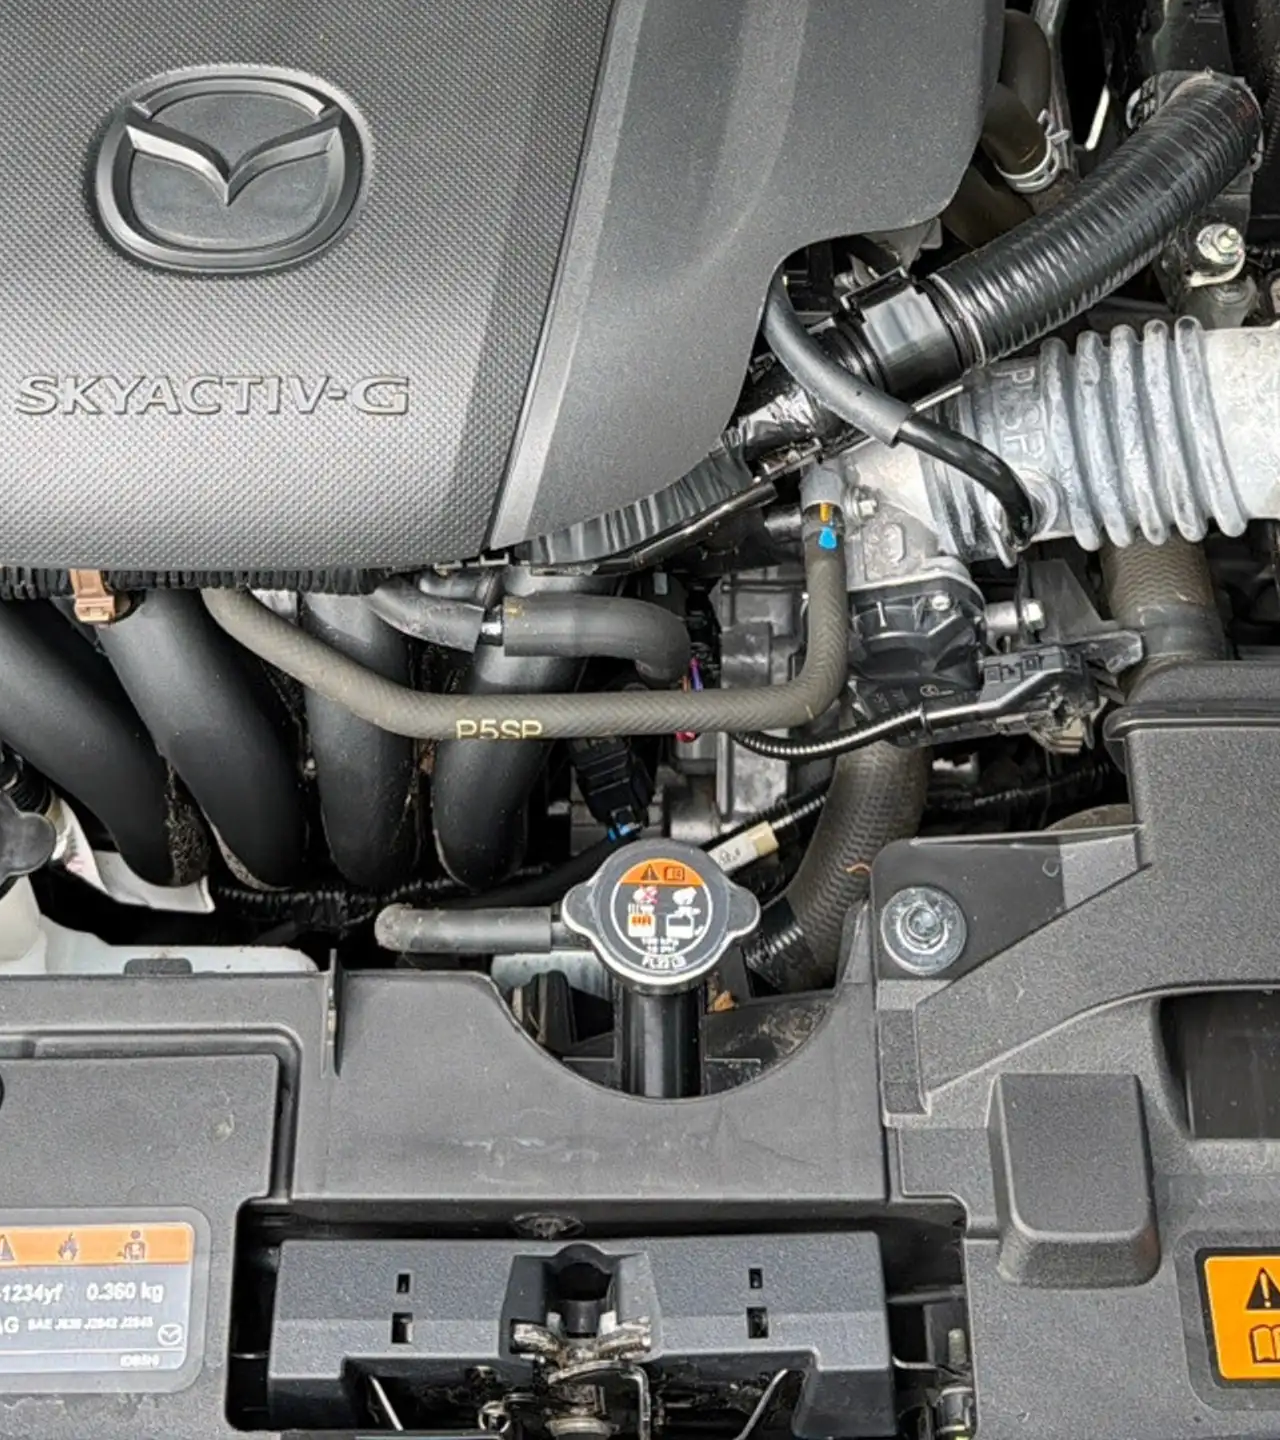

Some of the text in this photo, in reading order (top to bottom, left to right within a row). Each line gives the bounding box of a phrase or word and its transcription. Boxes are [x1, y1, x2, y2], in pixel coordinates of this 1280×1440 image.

[17, 374, 410, 416] SKYACTIV-G
[455, 718, 543, 740] P5SP
[140, 1281, 165, 1304] kg
